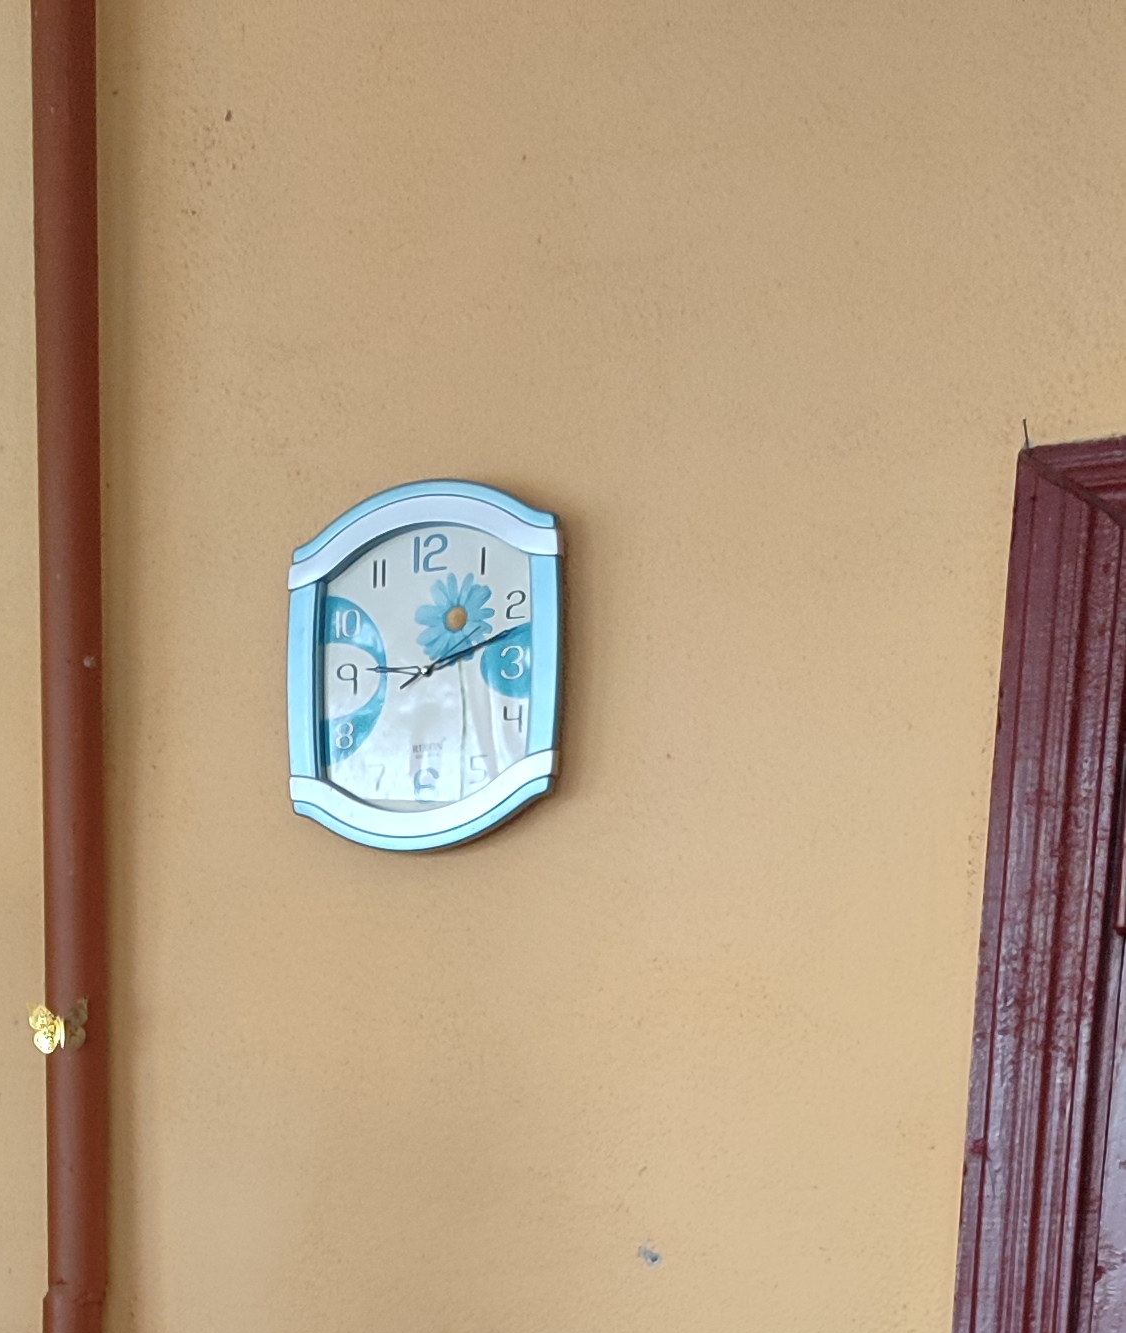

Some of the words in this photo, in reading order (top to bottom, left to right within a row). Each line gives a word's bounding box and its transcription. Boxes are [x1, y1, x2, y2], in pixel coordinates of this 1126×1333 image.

[412, 533, 450, 573] 12
[372, 558, 387, 588] 11
[505, 589, 527, 619] 2
[334, 608, 362, 638] 10
[499, 644, 525, 680] 3
[336, 662, 358, 695] 9
[502, 704, 523, 733] 4
[335, 721, 355, 750] 8
[367, 763, 386, 791] 7
[469, 754, 489, 785] 5
